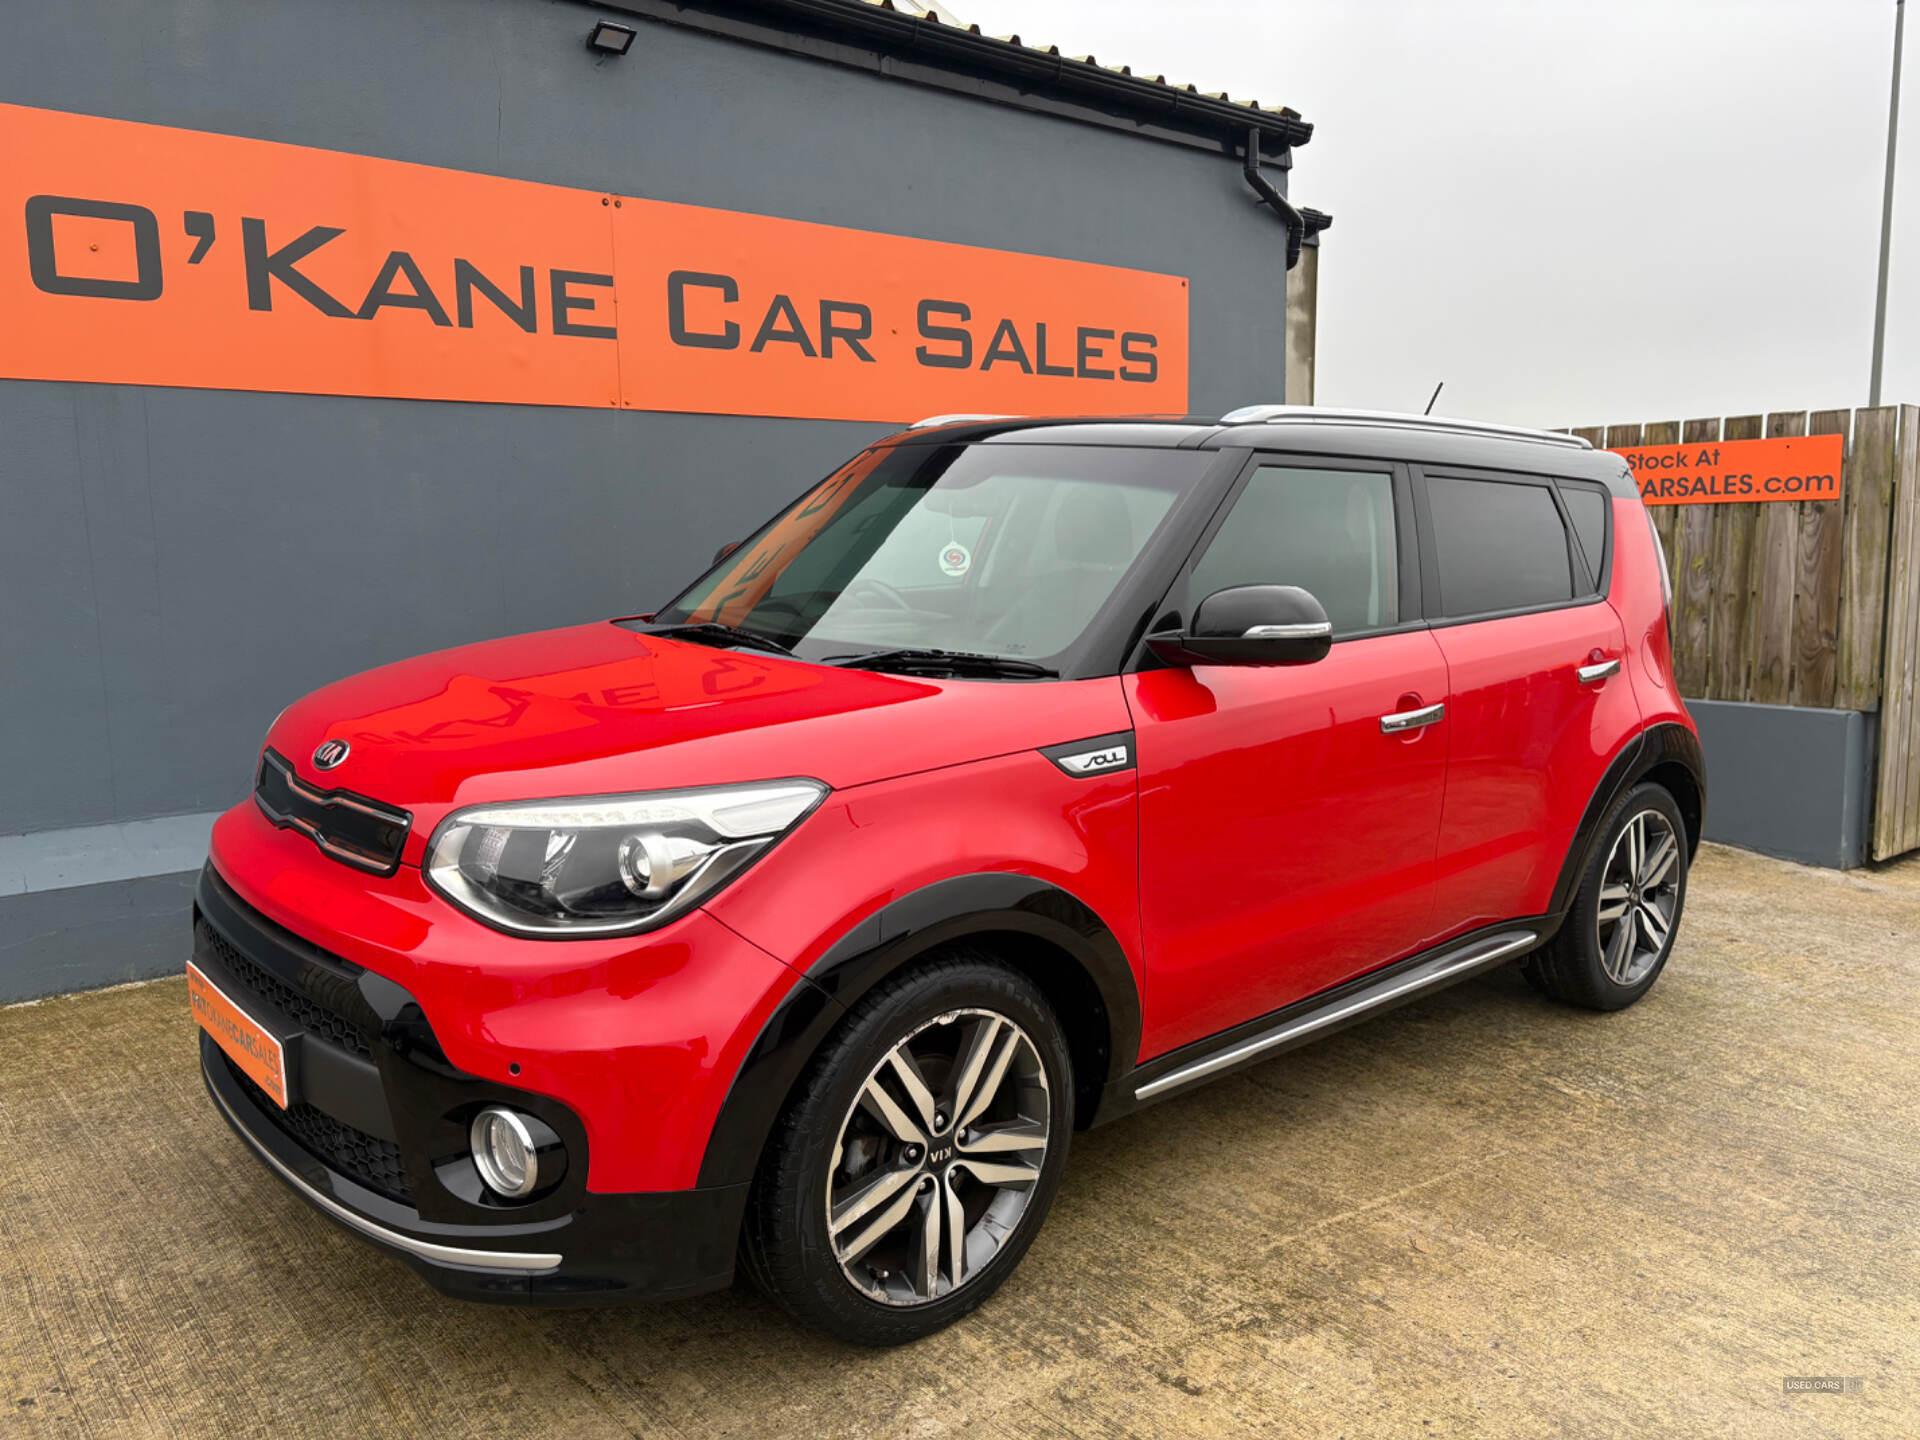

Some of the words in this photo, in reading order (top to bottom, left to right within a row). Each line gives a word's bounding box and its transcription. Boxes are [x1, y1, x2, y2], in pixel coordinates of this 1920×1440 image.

[25, 194, 618, 340] O'KANE
[667, 269, 877, 363] CAR
[915, 298, 1158, 383] SALES
[1626, 451, 1688, 470] Stock
[1695, 449, 1720, 466] At
[1636, 474, 1834, 497] ARSALES.com
